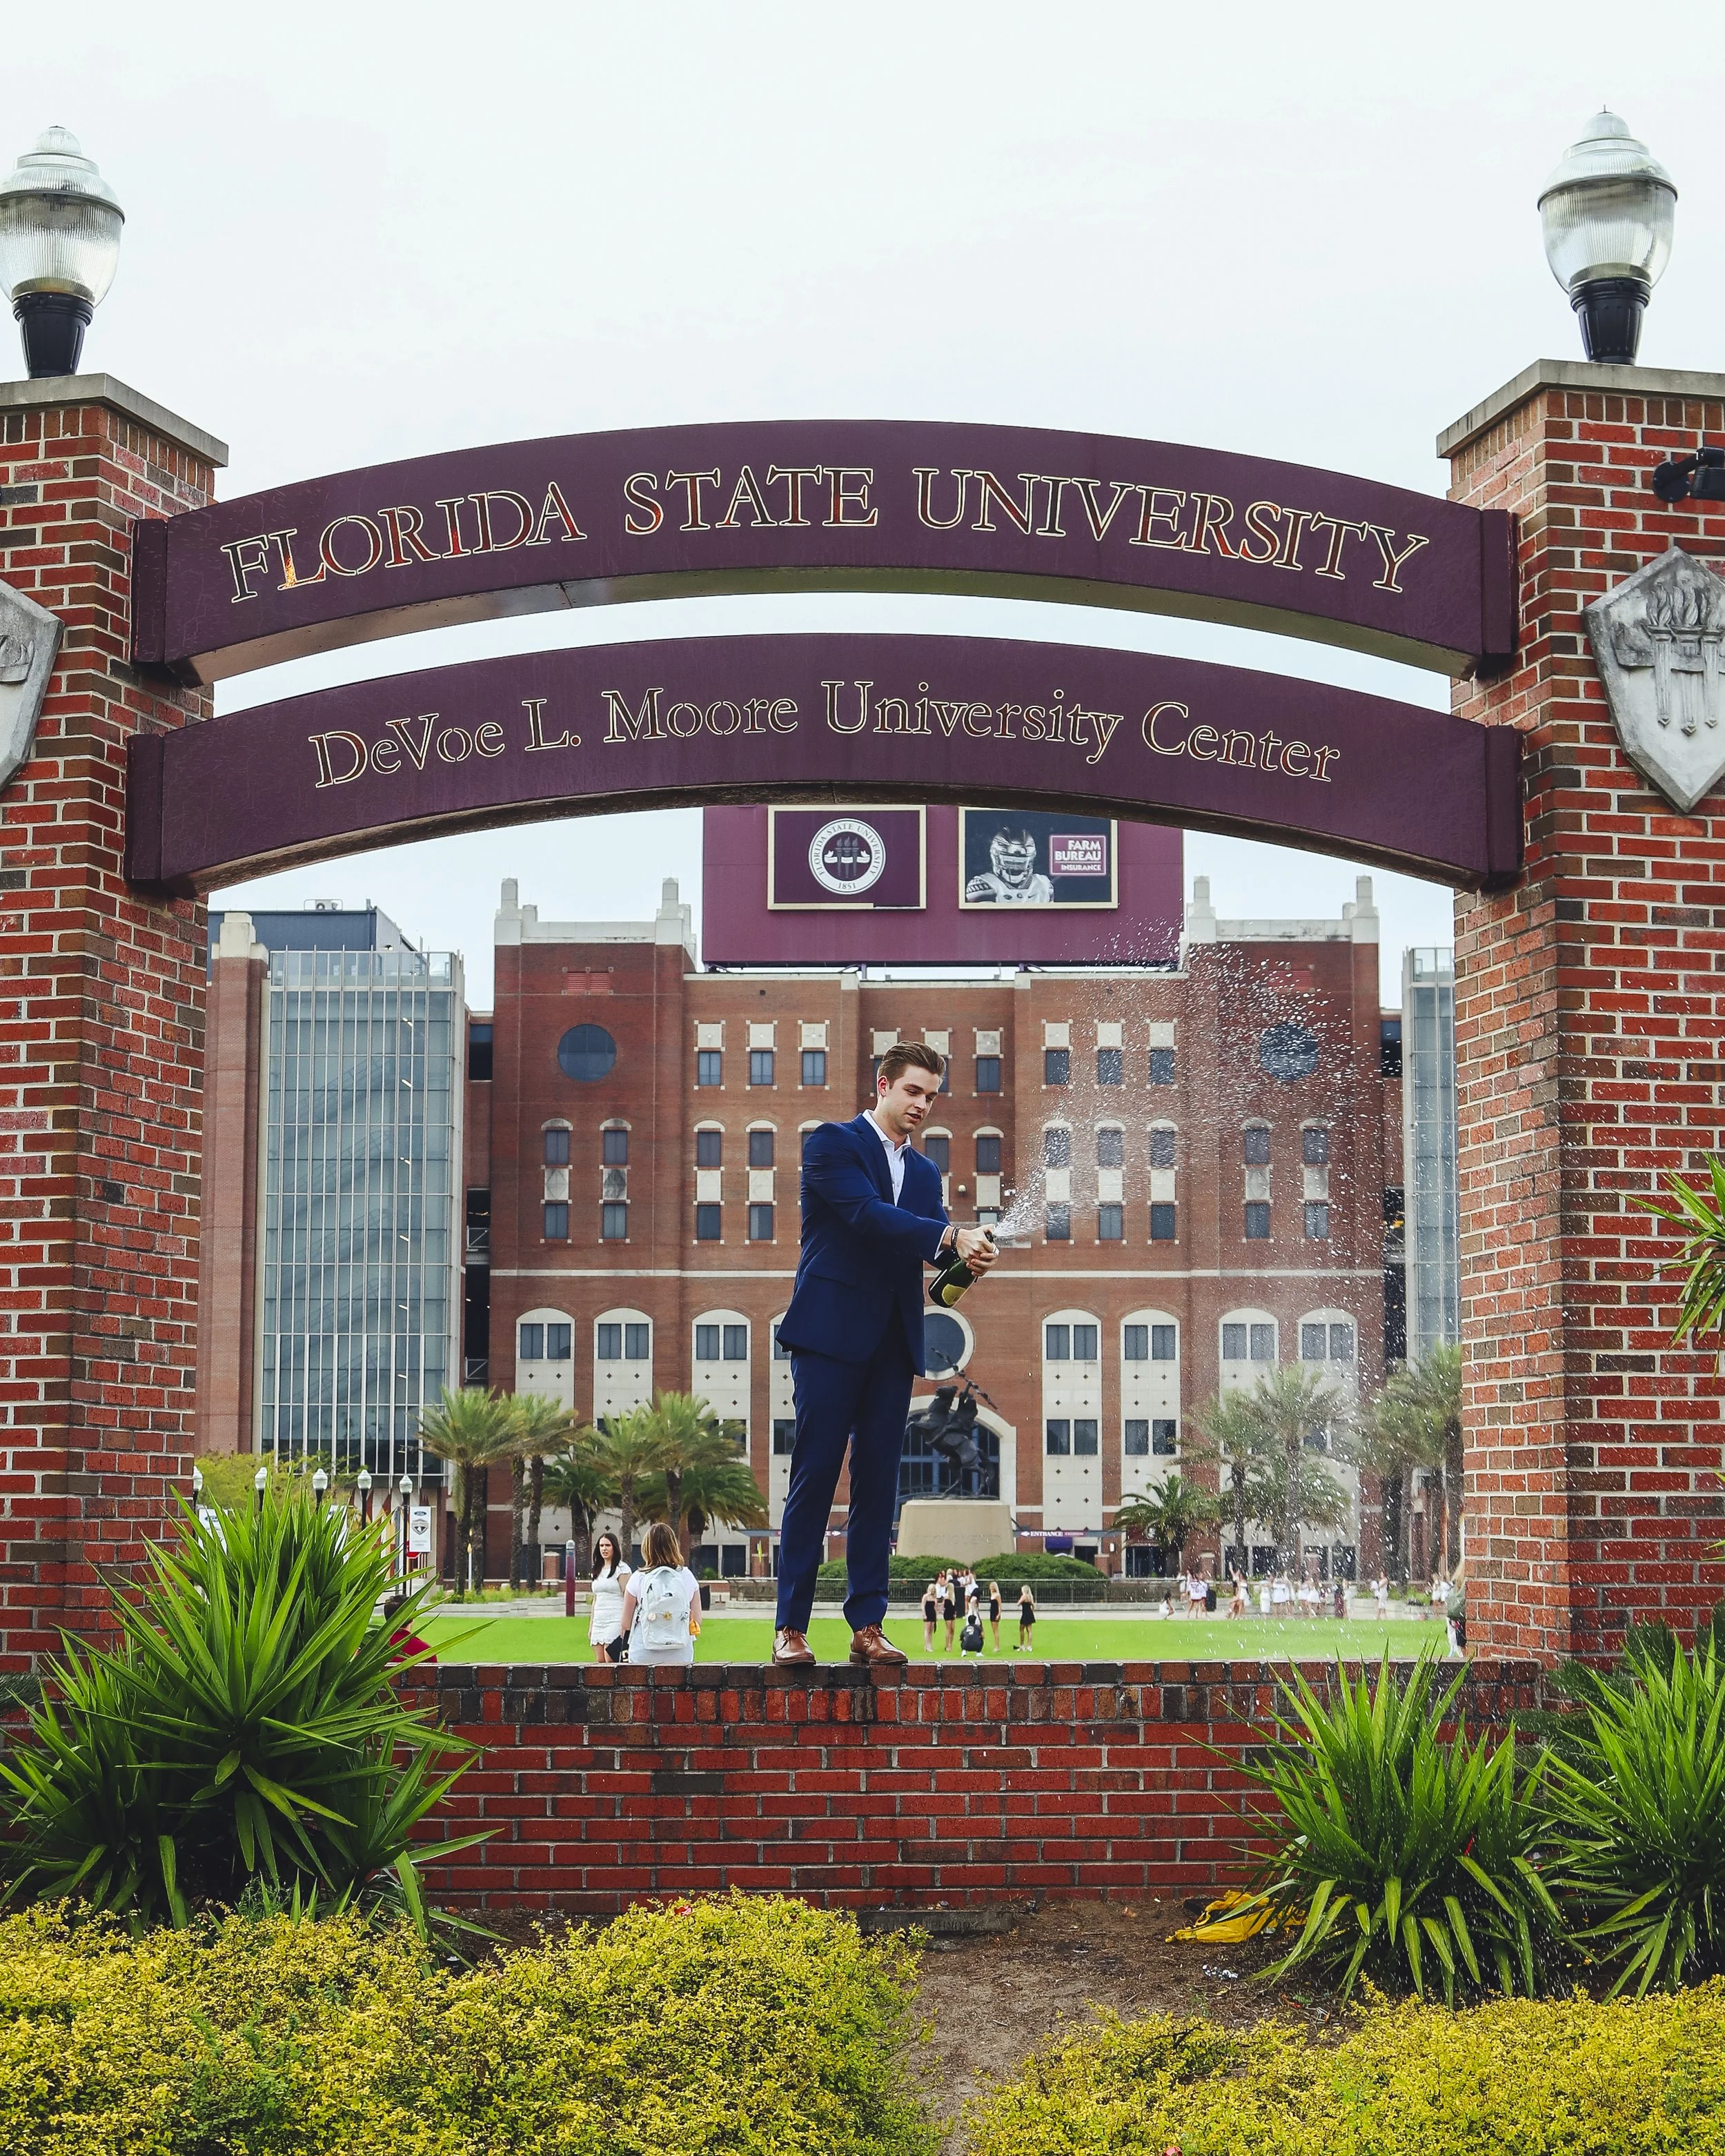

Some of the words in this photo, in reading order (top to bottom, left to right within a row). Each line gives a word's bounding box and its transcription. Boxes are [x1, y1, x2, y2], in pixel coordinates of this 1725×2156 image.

[220, 482, 587, 604] FLORIDA
[624, 465, 878, 535] STATE
[912, 468, 1429, 593] UNIVERSITY
[308, 712, 505, 788] DeVoe
[522, 699, 581, 751] L.
[601, 688, 798, 743] Moore
[821, 681, 1123, 764] University
[1142, 702, 1340, 782] Center
[814, 835, 827, 876] FLORIDA
[828, 823, 854, 835] STATE
[857, 826, 880, 876] UNIVERSITY
[1054, 850, 1101, 861] BUREAU
[1068, 840, 1101, 850] FARM
